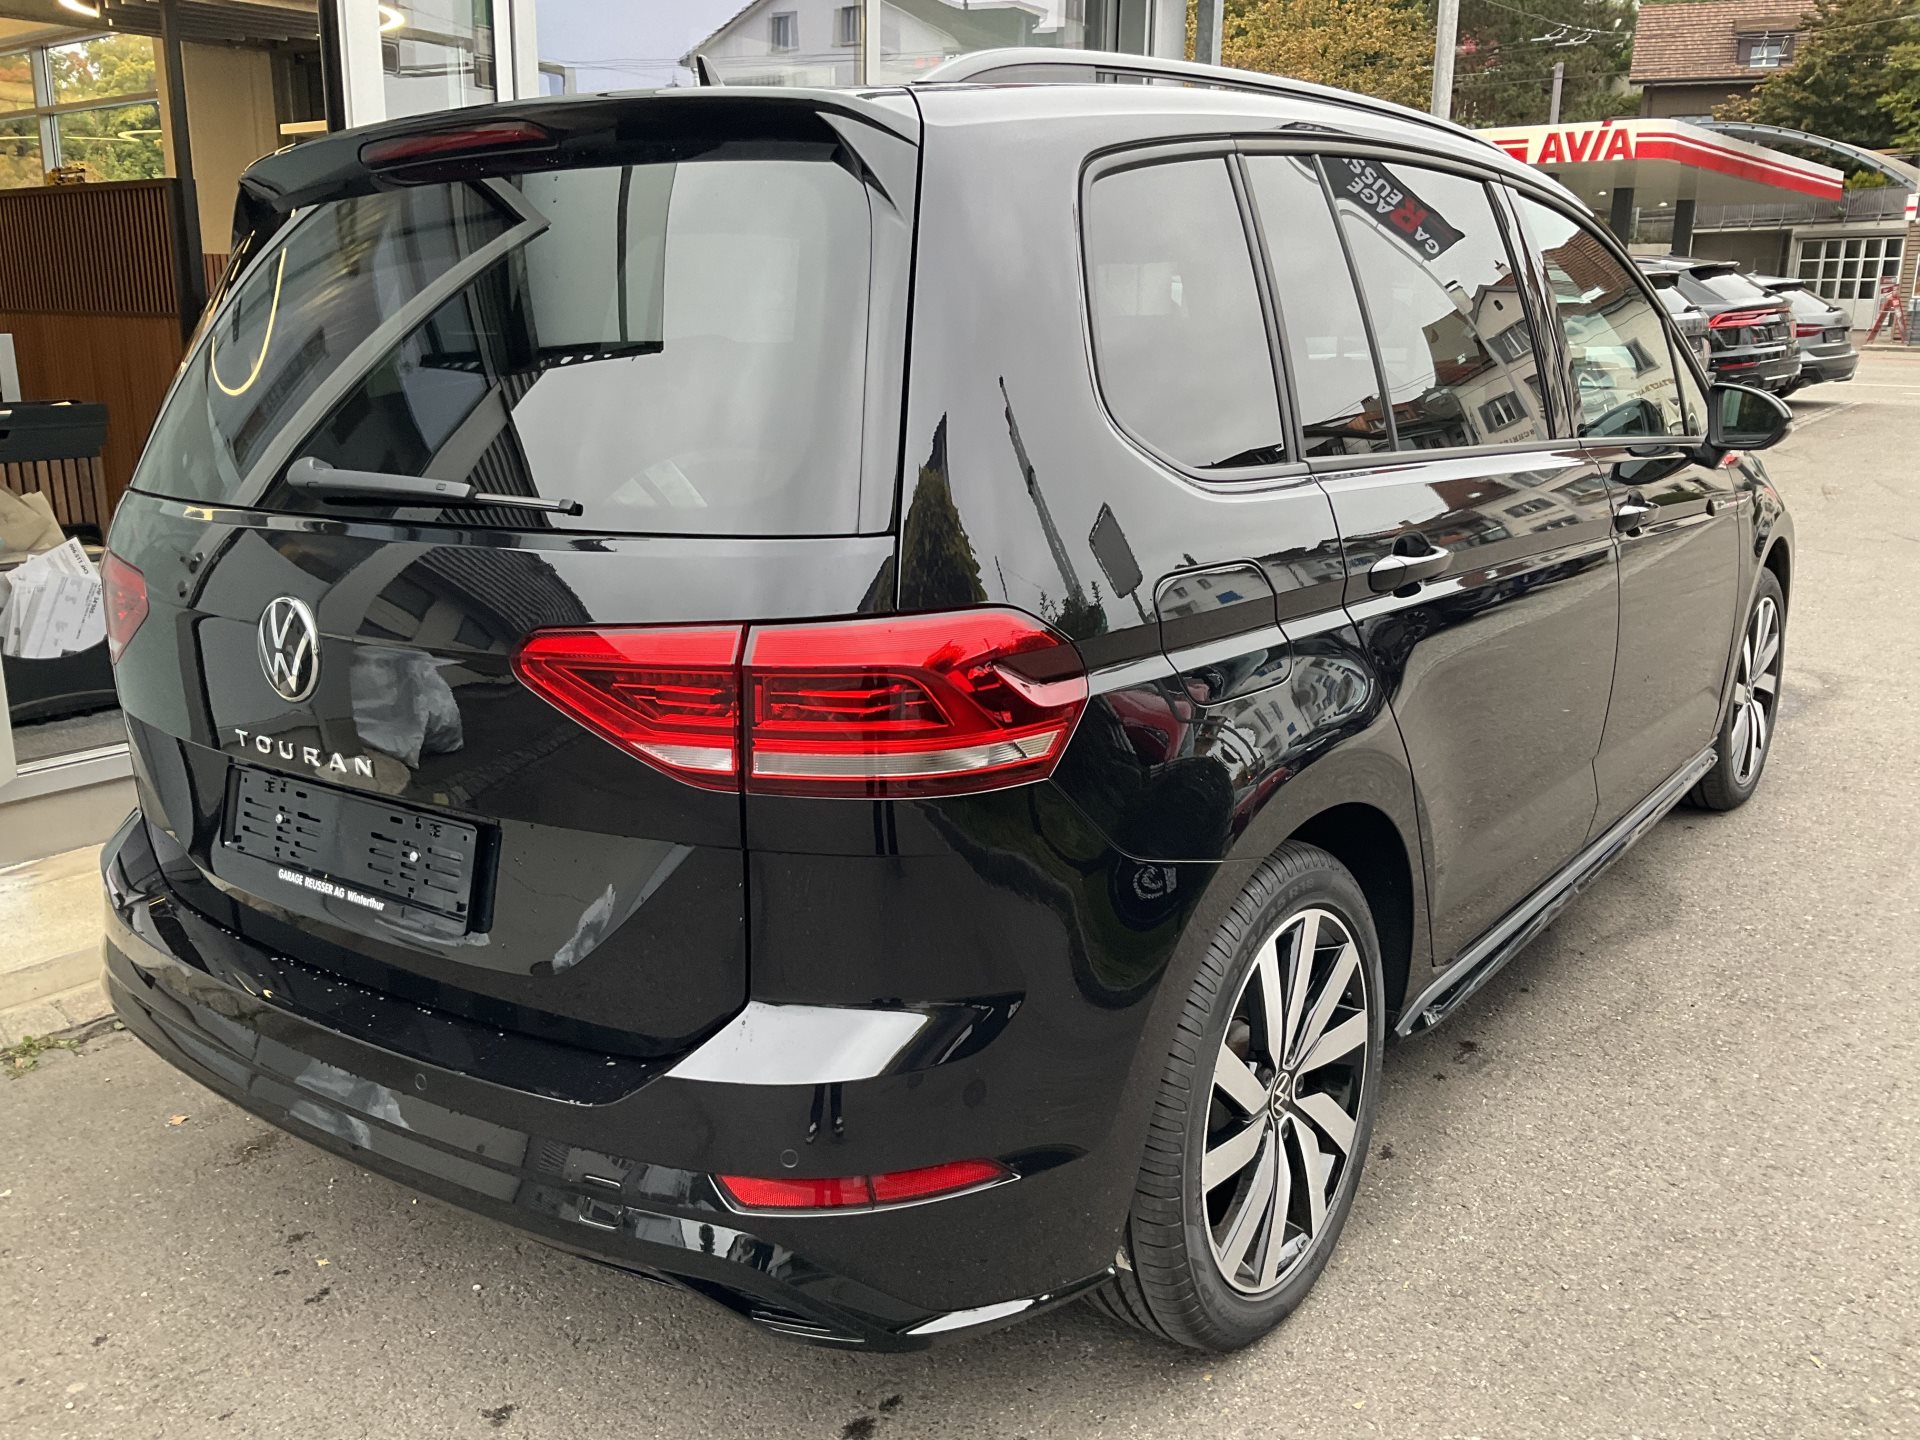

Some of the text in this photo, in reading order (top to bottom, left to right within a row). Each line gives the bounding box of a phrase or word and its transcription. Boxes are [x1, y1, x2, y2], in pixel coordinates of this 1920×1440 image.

[234, 728, 375, 778] TOURAN
[278, 868, 385, 911] GARAGE REUSSER AG Winterthur
